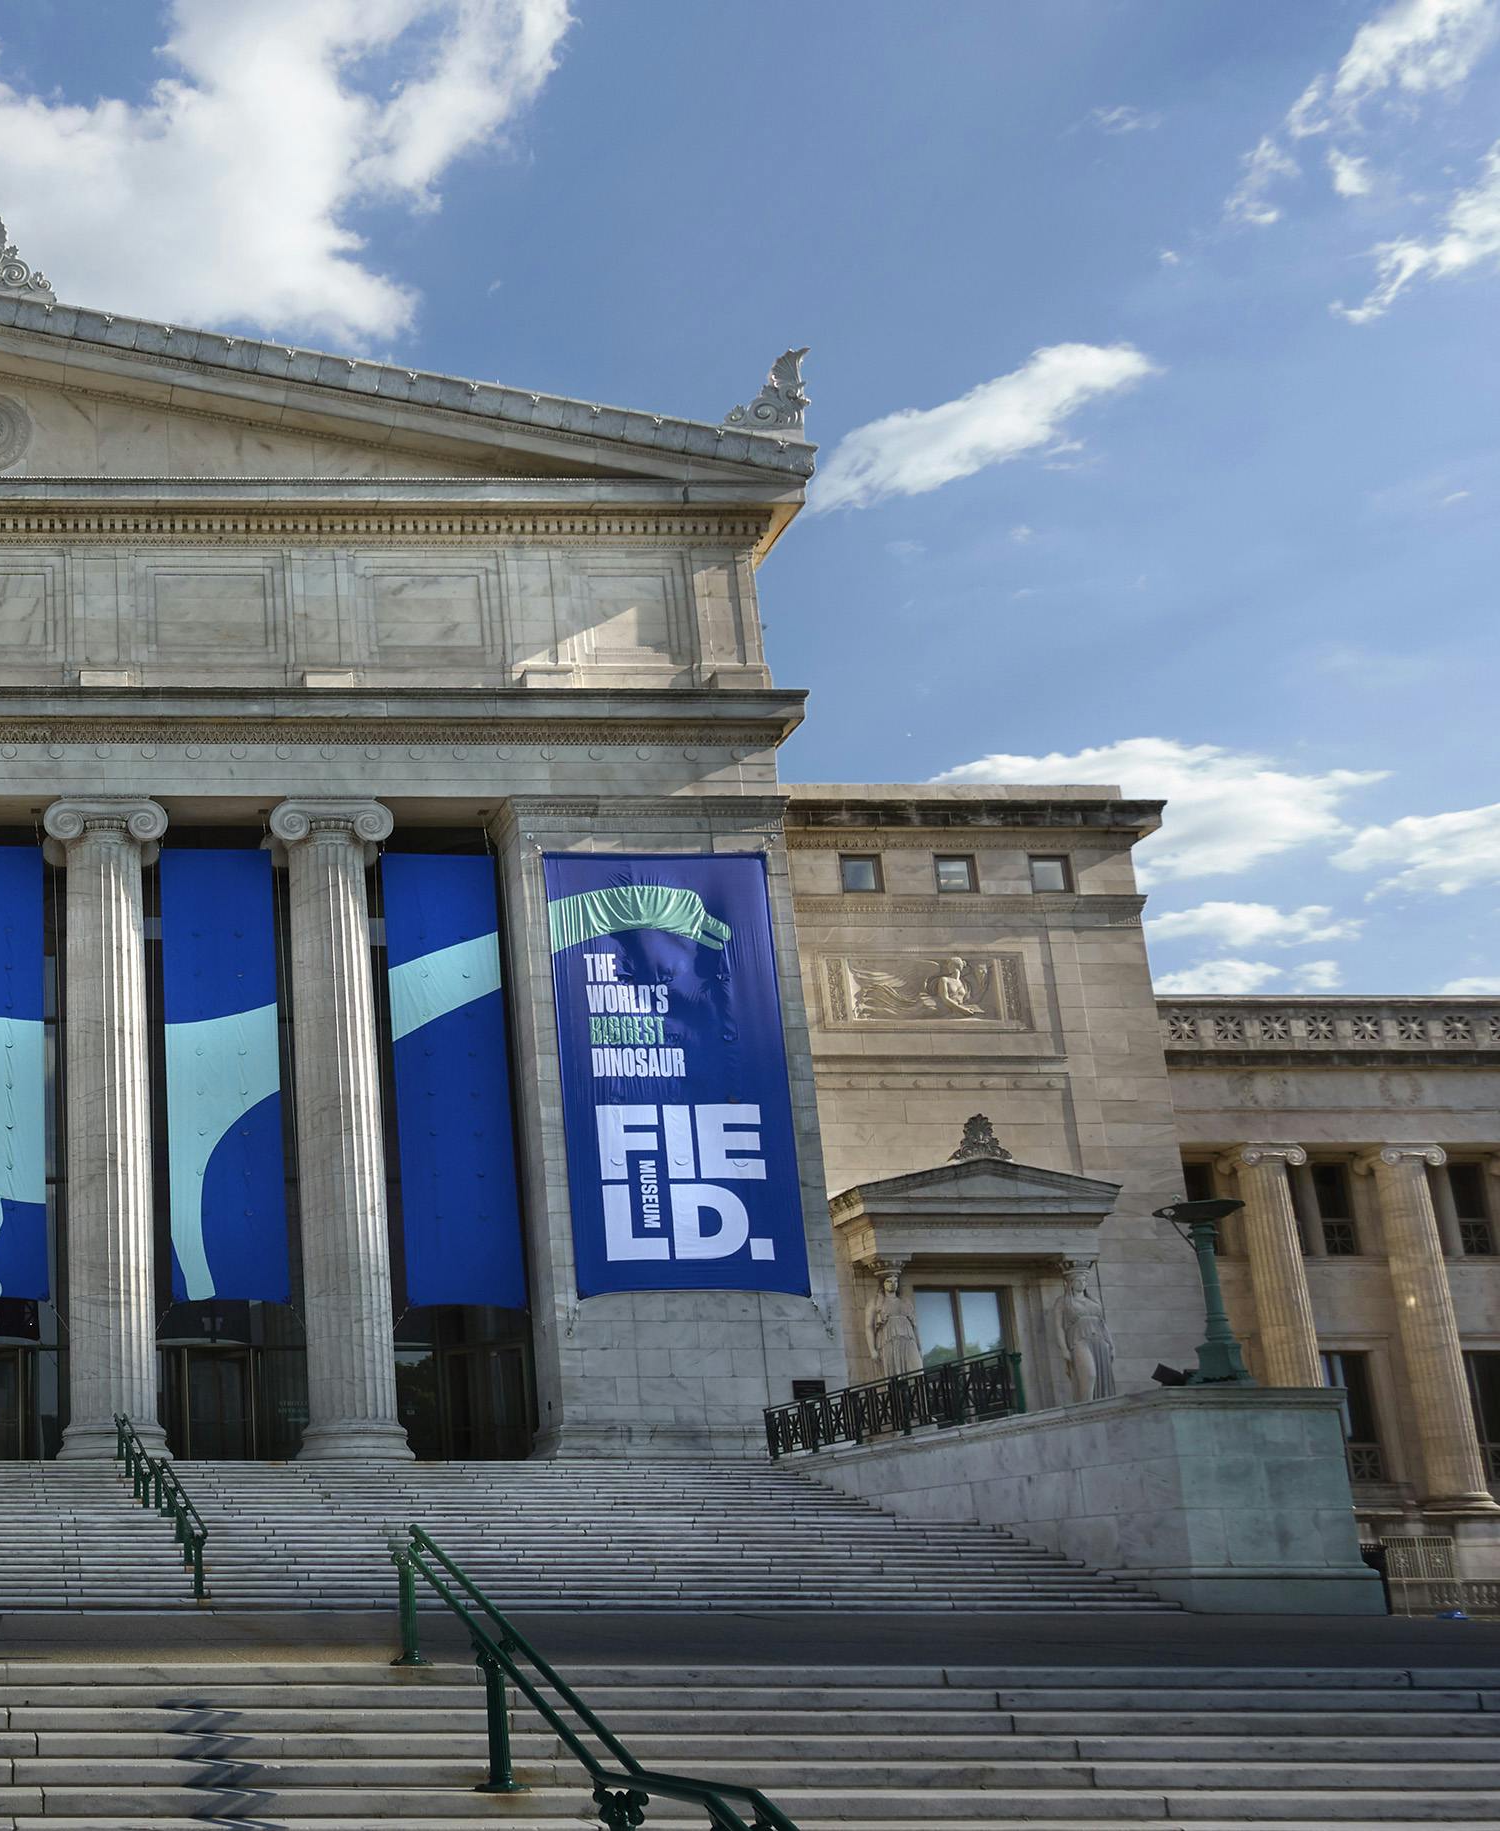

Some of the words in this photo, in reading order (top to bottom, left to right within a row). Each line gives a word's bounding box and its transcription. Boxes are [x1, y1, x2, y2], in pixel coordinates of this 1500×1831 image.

[583, 953, 617, 982] THE
[586, 984, 669, 1014] WORLD'S
[589, 1016, 665, 1045] BIGGEST
[592, 1048, 686, 1078] DINOSAUR
[639, 1160, 661, 1229] MUSEUM
